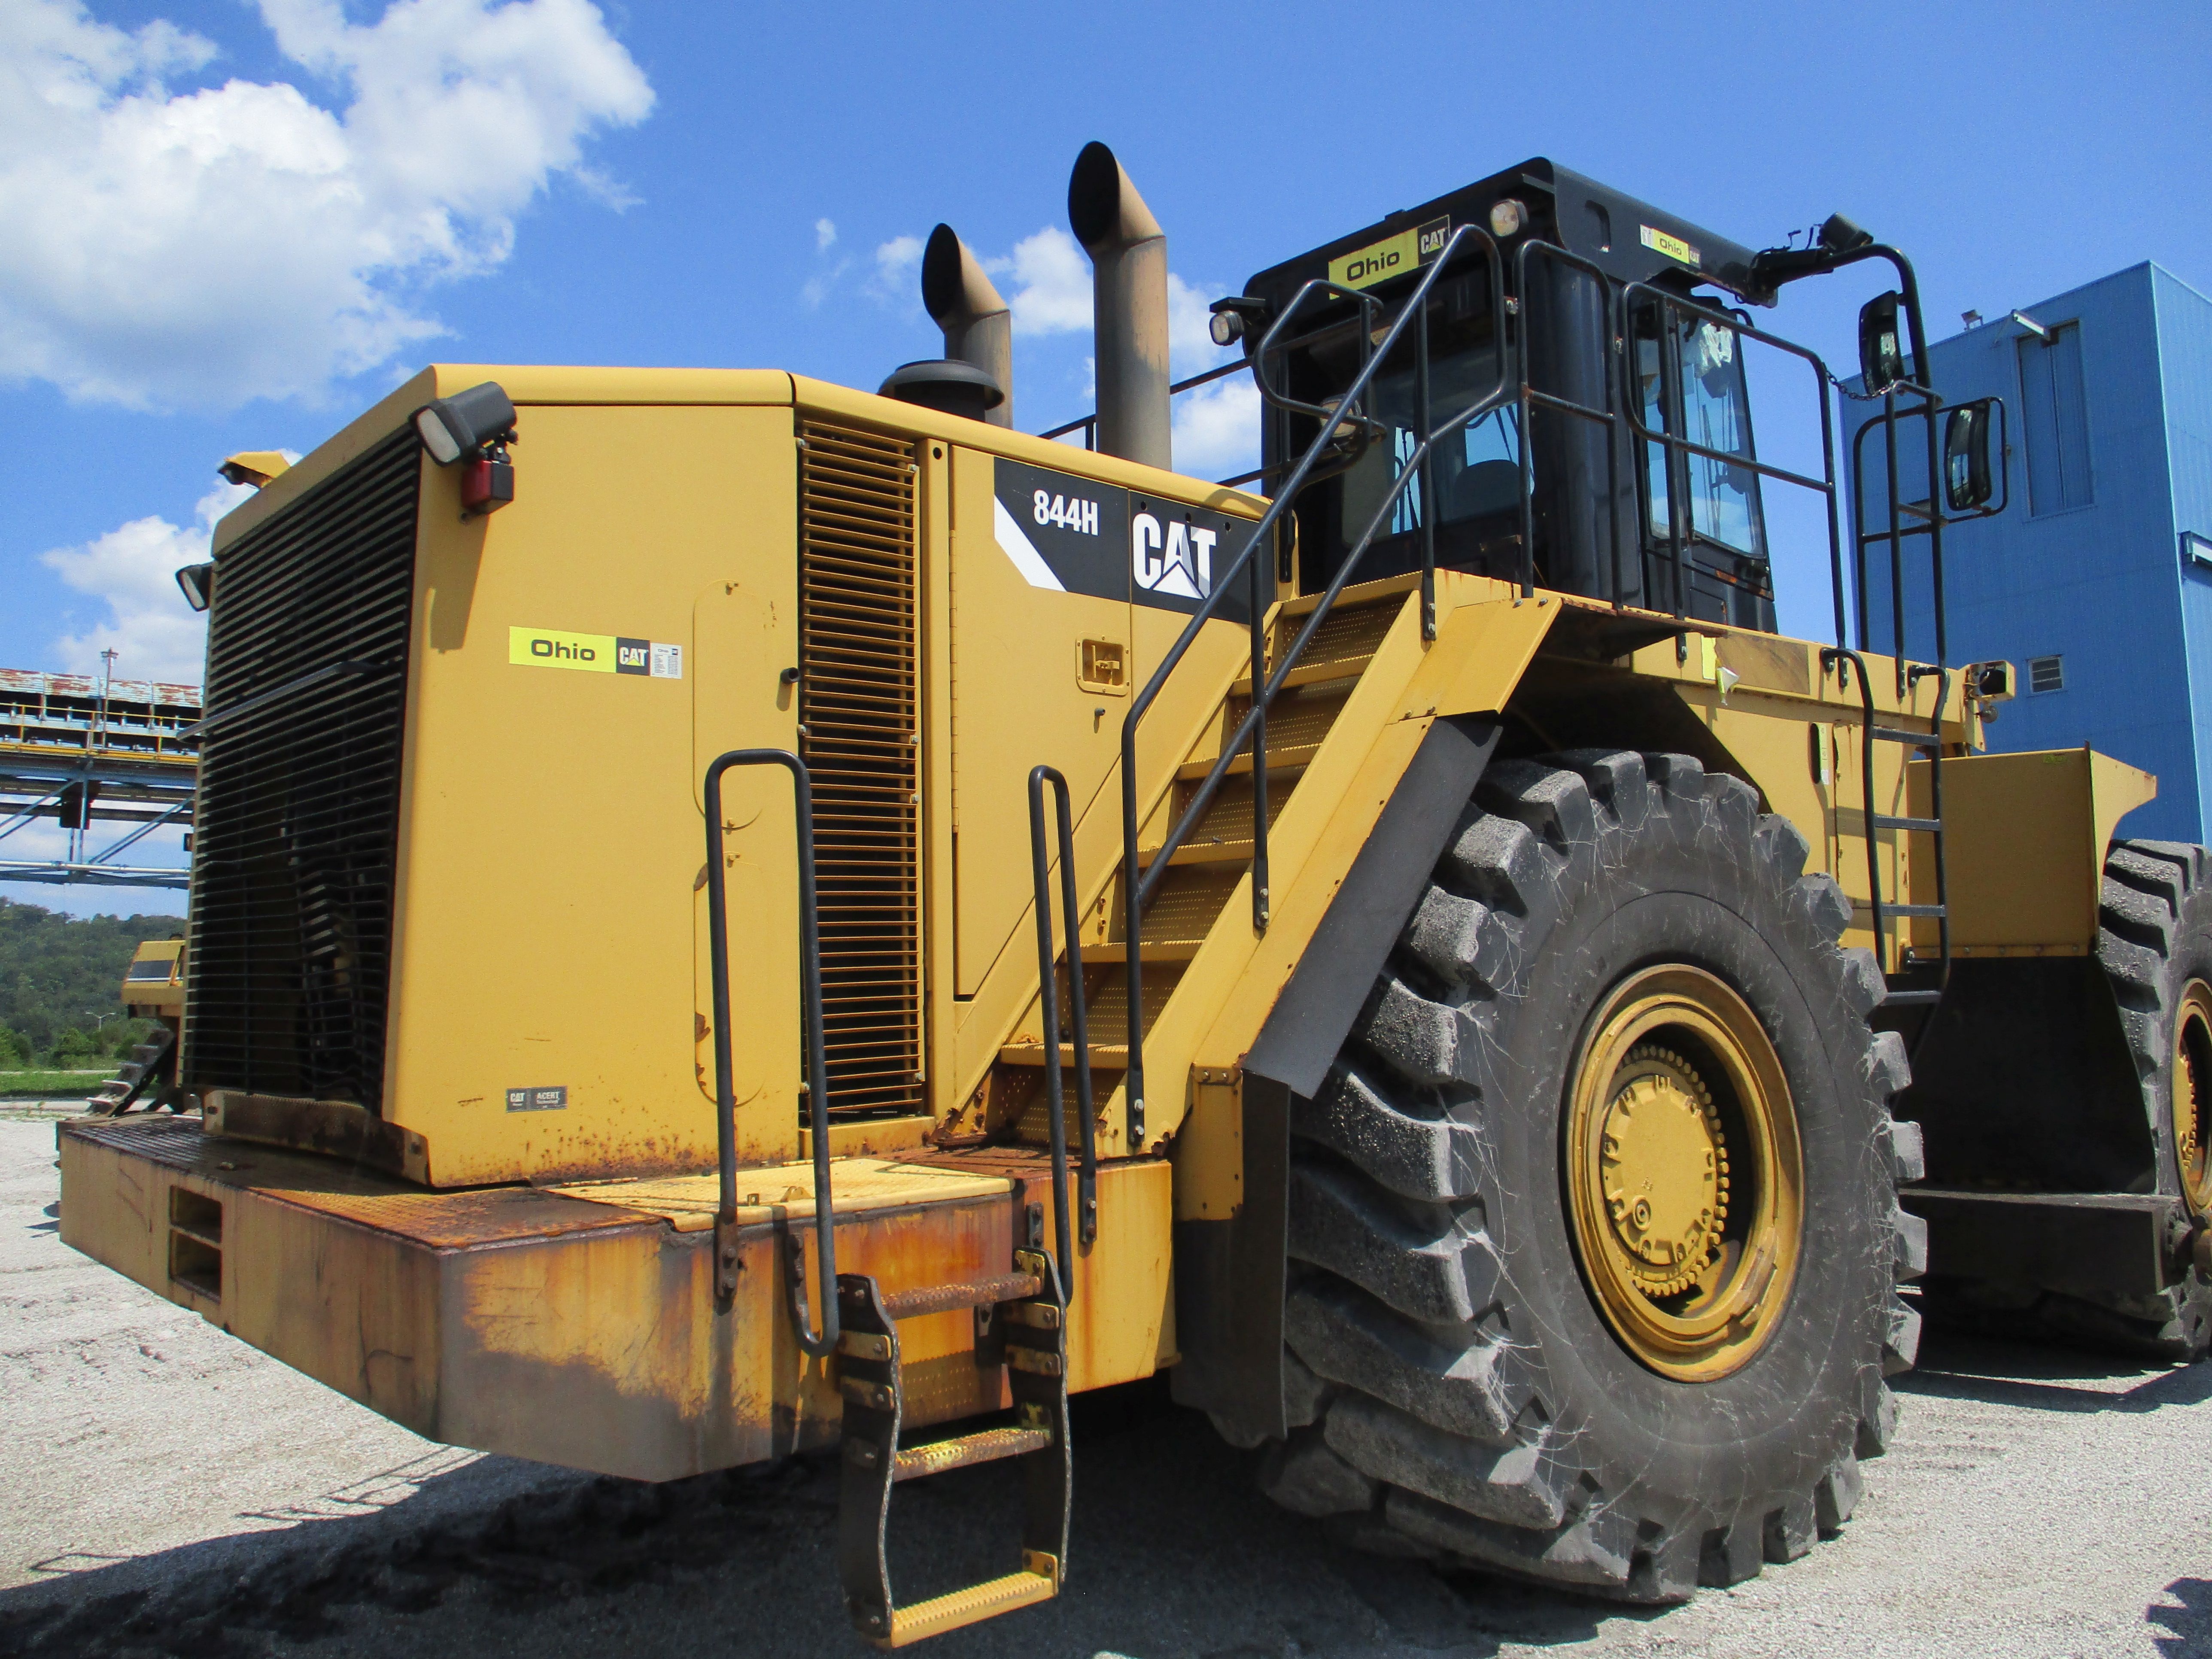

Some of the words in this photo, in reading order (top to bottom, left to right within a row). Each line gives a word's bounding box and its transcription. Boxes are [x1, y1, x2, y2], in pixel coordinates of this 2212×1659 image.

[1347, 251, 1400, 281] Ohio
[1420, 227, 1447, 254] CAT
[1659, 238, 1682, 255] Ohio
[1033, 489, 1098, 536] 844H
[1133, 513, 1216, 600] CAT
[531, 639, 596, 661] Ohio
[620, 647, 649, 666] CAT
[510, 1093, 525, 1103] CAT
[536, 1091, 560, 1100] ACERT
